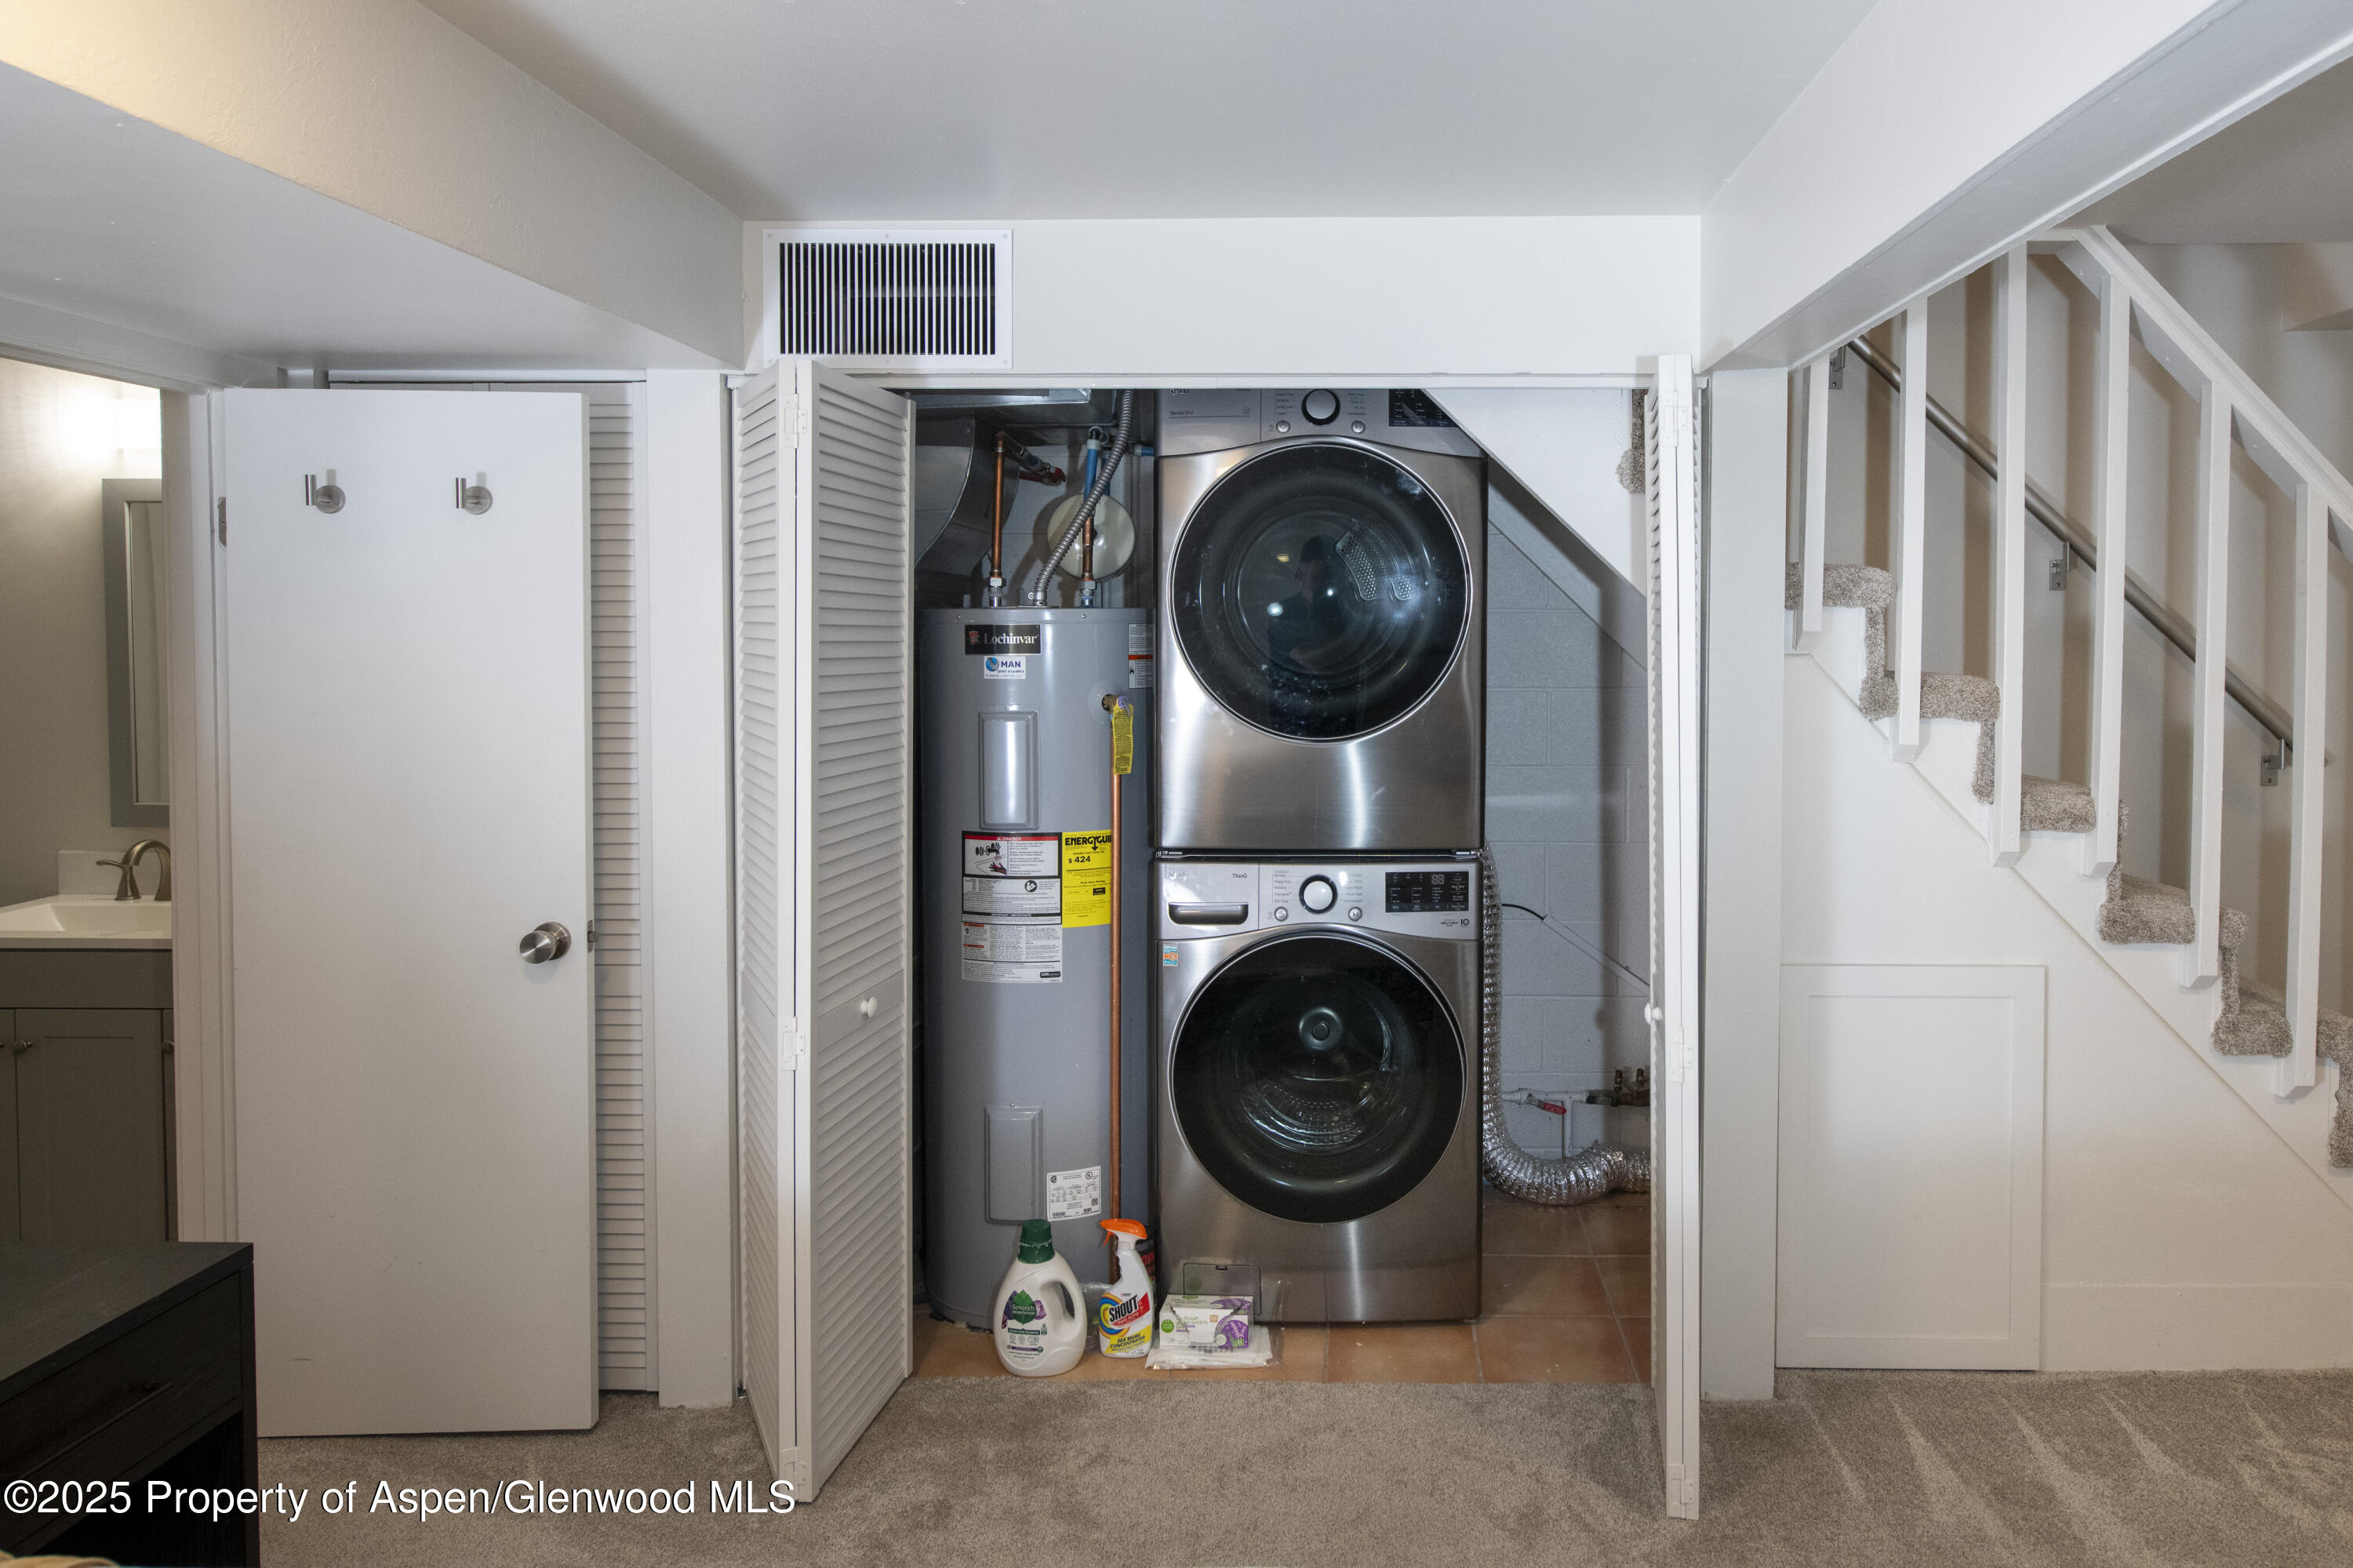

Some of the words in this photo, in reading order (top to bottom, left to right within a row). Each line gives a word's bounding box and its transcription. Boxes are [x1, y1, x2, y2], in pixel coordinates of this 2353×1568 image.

[984, 632, 1037, 644] Lochinvar
[1065, 835, 1111, 847] ENERGYGUI
[1108, 1294, 1138, 1322] SHOUT
[1110, 1335, 1146, 1348] CONCENTRATED
